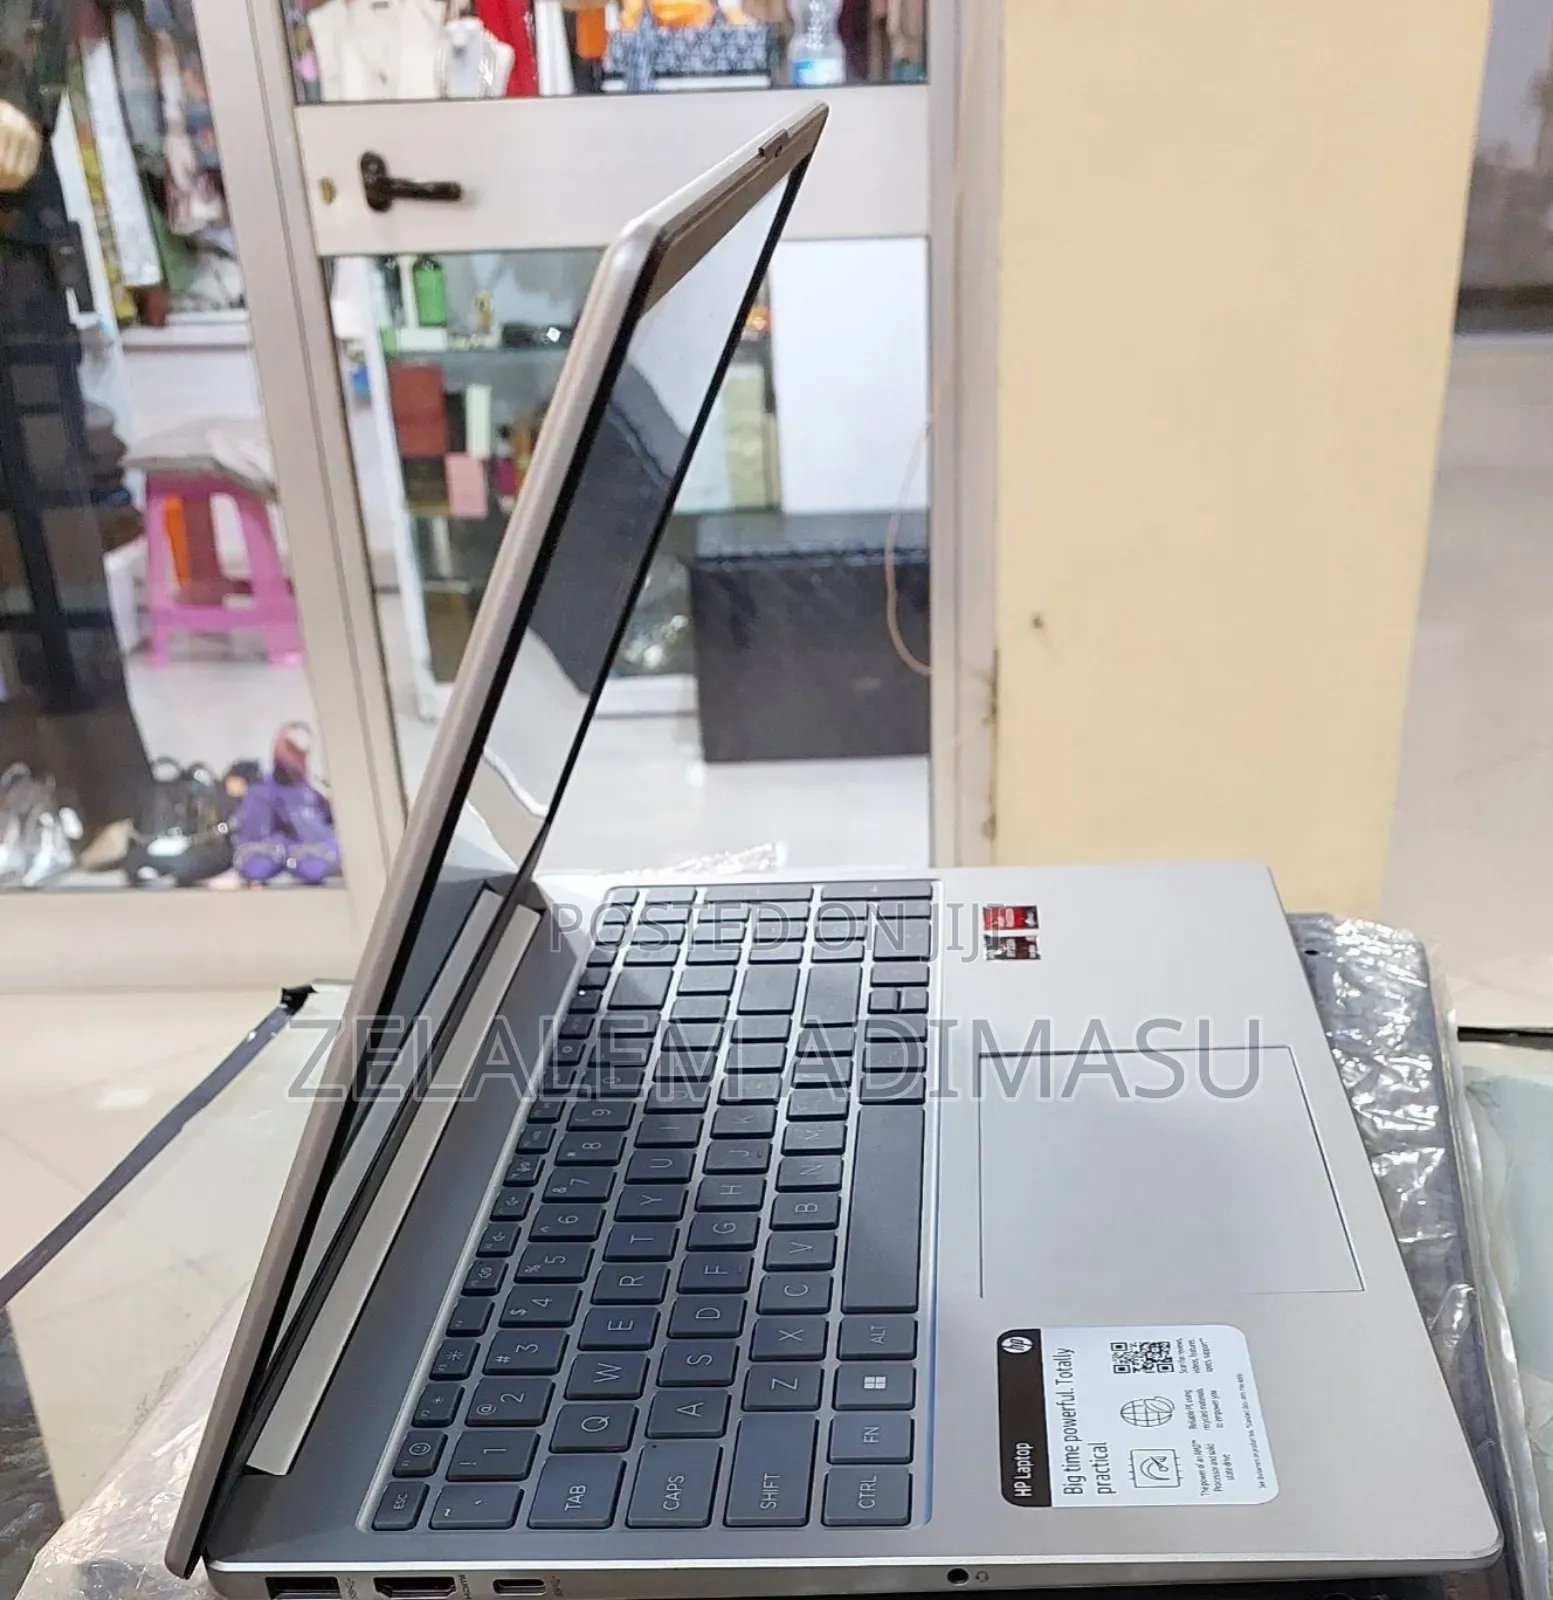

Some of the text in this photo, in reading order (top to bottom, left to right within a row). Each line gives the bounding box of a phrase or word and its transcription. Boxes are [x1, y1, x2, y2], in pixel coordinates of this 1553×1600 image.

[592, 1109, 612, 1117] 9
[582, 1142, 602, 1150] 8
[650, 1158, 673, 1169] U
[799, 1164, 824, 1176] N
[570, 1178, 590, 1187] 7
[719, 1185, 742, 1195] H
[639, 1195, 664, 1206] Y
[795, 1202, 818, 1213] B
[558, 1215, 579, 1225] 6
[712, 1222, 736, 1235] G
[630, 1234, 654, 1245] T
[789, 1242, 814, 1254] V
[544, 1255, 566, 1264] 5
[704, 1264, 728, 1275] F
[619, 1275, 645, 1287] R
[784, 1284, 809, 1297] C
[531, 1297, 553, 1308] 4
[695, 1307, 721, 1319] D
[607, 1320, 634, 1331] E
[778, 1328, 804, 1342] X
[870, 1325, 887, 1345] ALT
[515, 1343, 539, 1353] 3
[1001, 1336, 1033, 1354] hp
[687, 1354, 713, 1366] S
[593, 1363, 623, 1383] W
[771, 1377, 798, 1392] Z
[500, 1392, 525, 1403] 2
[676, 1402, 704, 1418] A
[581, 1415, 610, 1433] Q
[1052, 1347, 1087, 1495] Big time powerful. Totally
[863, 1425, 881, 1443] FN
[1013, 1442, 1034, 1497] HP Laptop
[1088, 1441, 1117, 1495] practical
[662, 1474, 685, 1511] CAPS
[760, 1472, 781, 1510] SHIFT
[858, 1474, 877, 1510] CTRL
[393, 1493, 408, 1510] ESC
[564, 1484, 587, 1512] TAB
